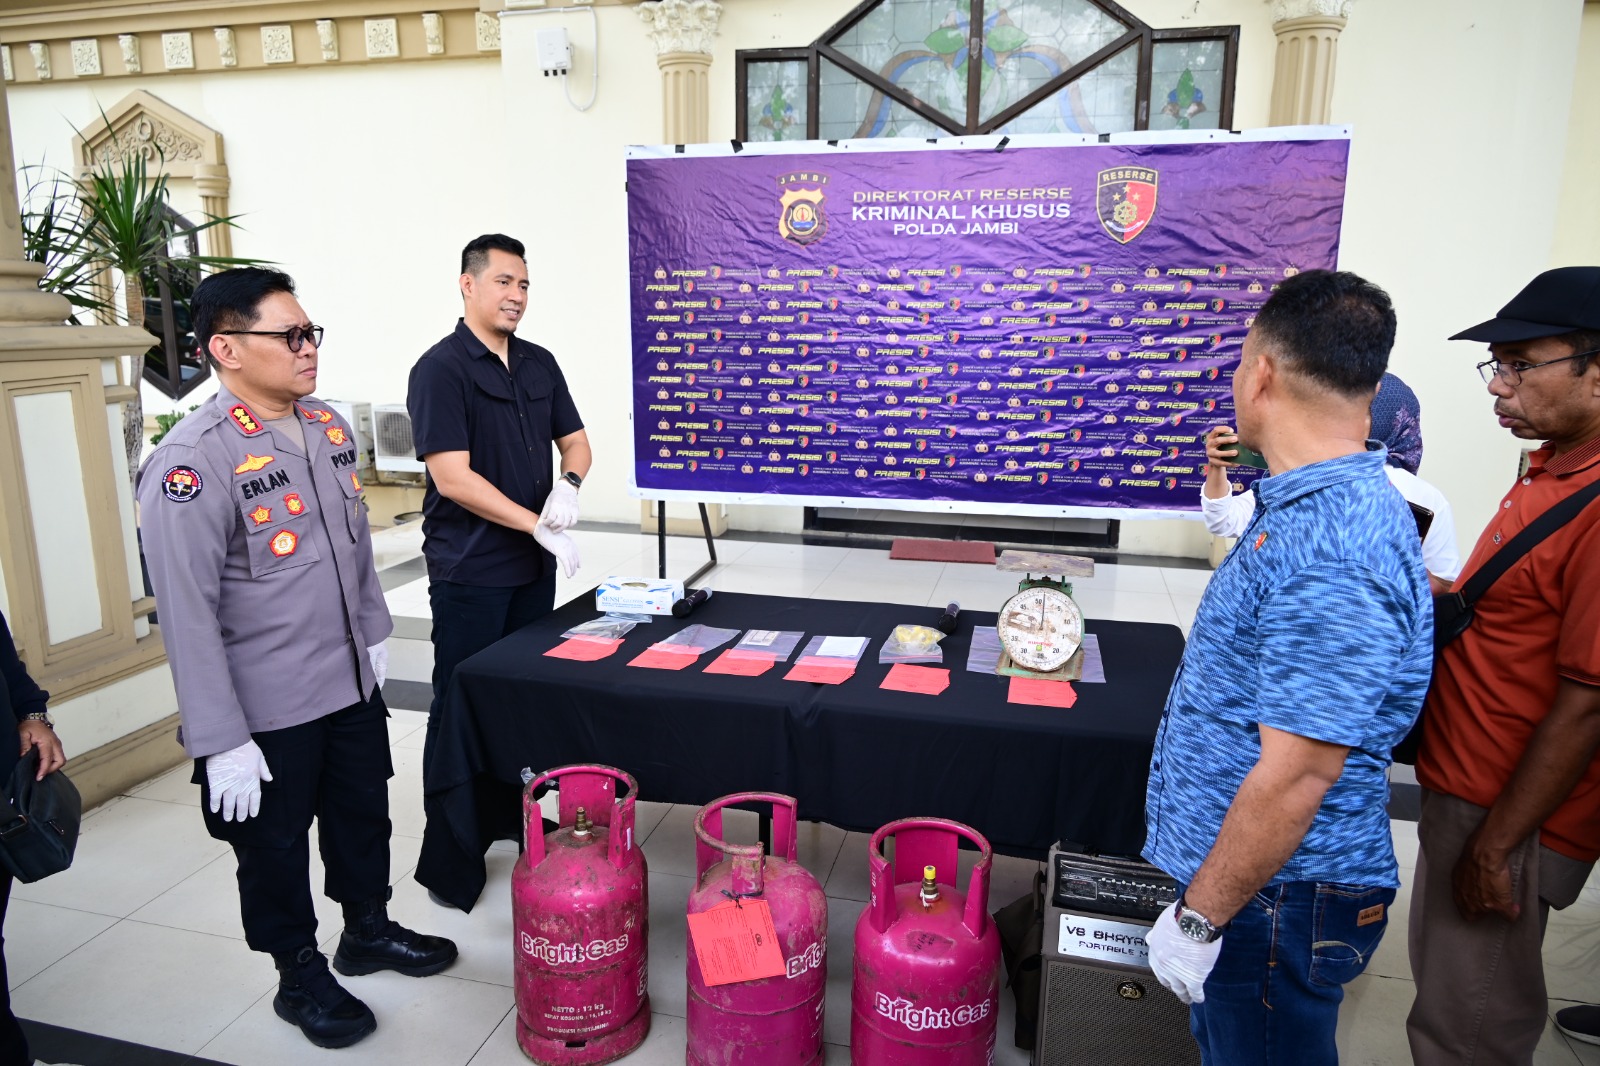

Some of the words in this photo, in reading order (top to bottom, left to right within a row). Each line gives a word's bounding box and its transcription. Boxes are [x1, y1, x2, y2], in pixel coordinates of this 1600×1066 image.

[780, 174, 826, 185] JAMBI
[1102, 170, 1154, 182] RESERSE
[853, 190, 974, 203] DIREKTORAT
[980, 188, 1072, 200] RESERSE
[852, 205, 965, 221] KRIMINAL
[972, 203, 1070, 219] KHUSUS
[894, 223, 957, 235] POLDA
[961, 222, 1018, 234] JAMBI
[671, 270, 707, 278] PRESISI
[1166, 268, 1210, 277] PRESISI
[644, 284, 680, 292] PRESISI
[1133, 284, 1175, 292] PRESISI
[672, 300, 708, 309] PRESISI
[1164, 302, 1207, 311] PRESISI
[646, 314, 681, 323] PRESISI
[1131, 318, 1173, 326] PRESISI
[647, 346, 682, 354] PRESISI
[1128, 352, 1170, 360] PRESISI
[1126, 384, 1168, 393] PRESISI
[1157, 402, 1199, 410] PRESISI
[996, 412, 1036, 421] PRESISI
[1124, 416, 1166, 424] PRESISI
[675, 422, 710, 430] PRESISI
[759, 438, 795, 446] PRESISI
[1121, 448, 1163, 457] PRESISI
[759, 466, 795, 474] PRESISI
[1152, 466, 1194, 474] PRESISI
[241, 469, 291, 500] ERLAN
[1119, 480, 1161, 488] PRESISI
[1066, 926, 1086, 936] V8
[1094, 930, 1148, 946] BHAYA
[520, 931, 586, 966] Bright
[586, 934, 628, 960] Gas
[1079, 941, 1134, 956] PORTABLE
[876, 992, 951, 1031] Bright
[952, 998, 990, 1026] Gas
